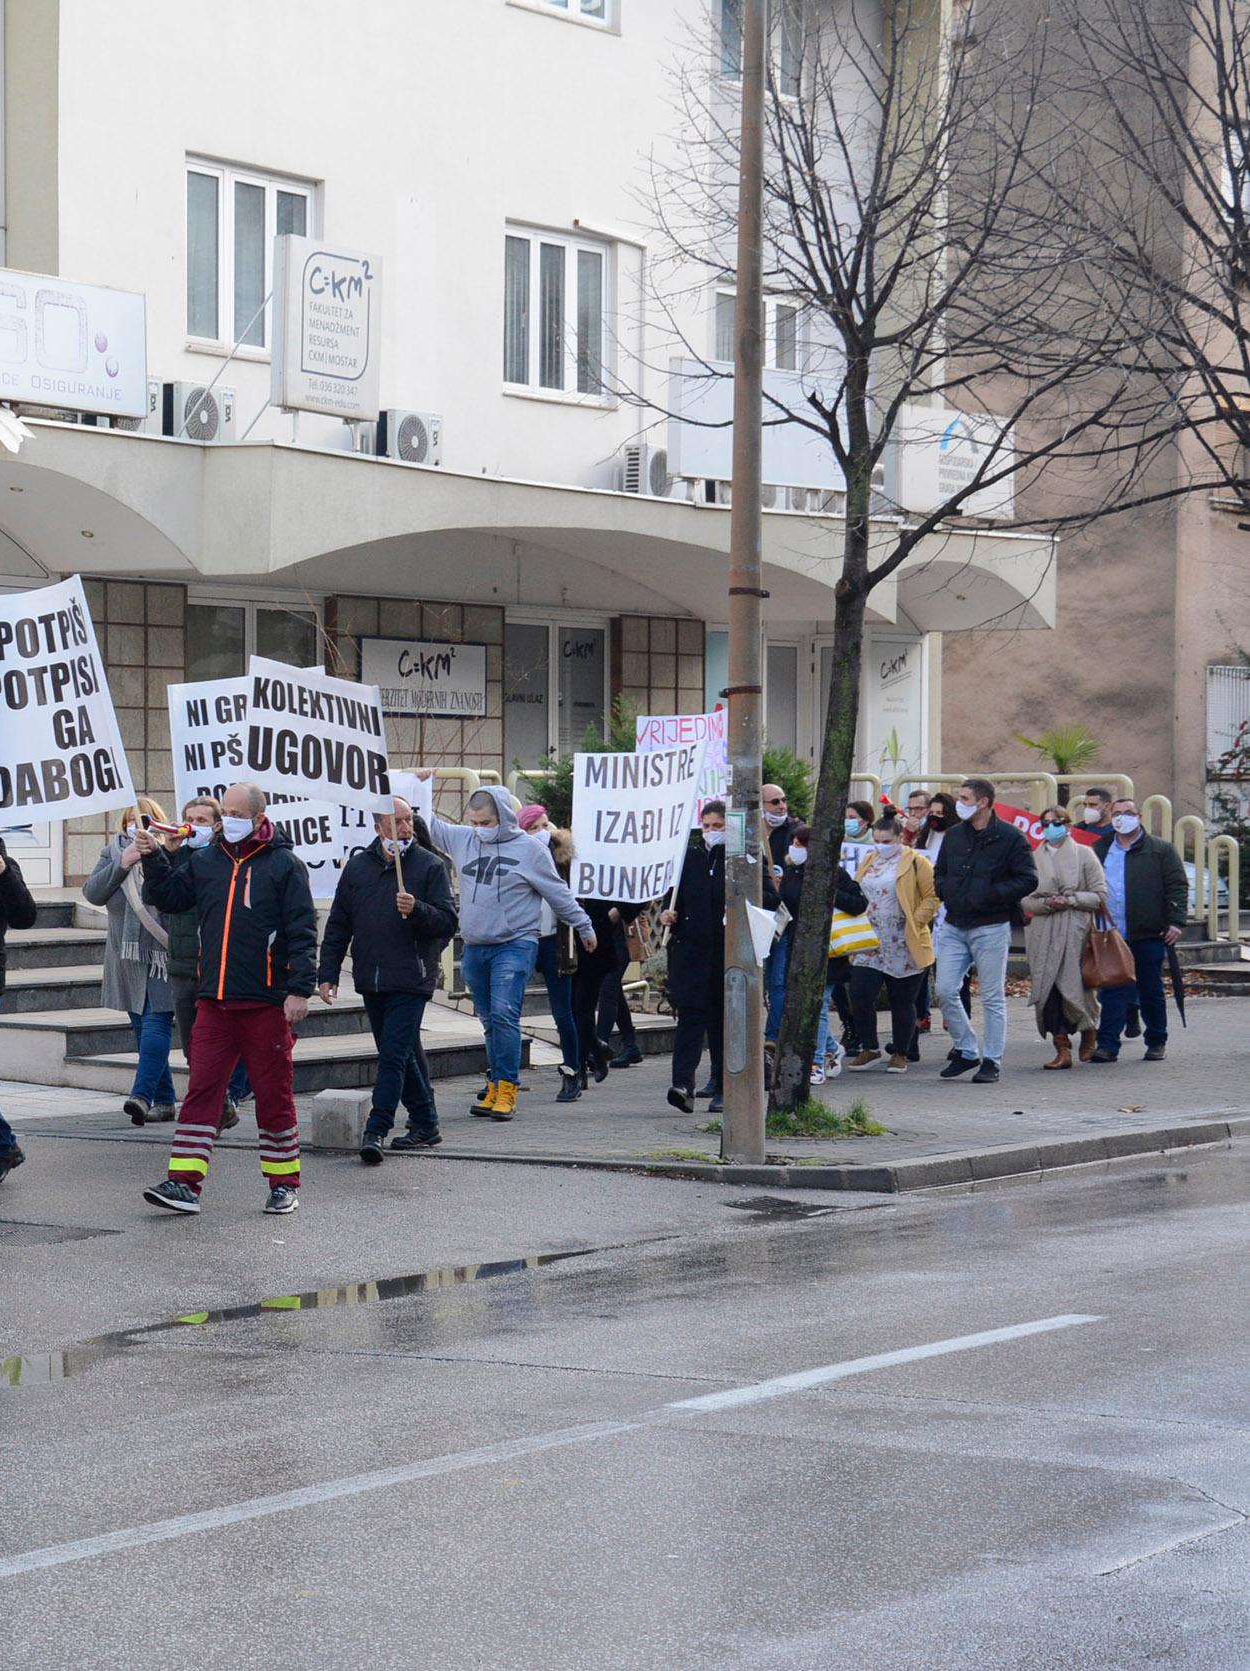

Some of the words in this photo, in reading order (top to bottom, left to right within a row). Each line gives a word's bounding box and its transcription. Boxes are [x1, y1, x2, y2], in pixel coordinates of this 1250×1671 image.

[309, 301, 343, 316] FAKULTET
[344, 308, 354, 320] ZA
[309, 318, 359, 337] MENADŽMENT
[309, 334, 339, 350] RESURSA
[186, 699, 210, 727] NI
[252, 676, 382, 737] KOLEKTIVNI
[52, 705, 95, 750] GA
[183, 742, 207, 772] NI
[247, 725, 391, 795] UGOVOR
[584, 744, 698, 789] MINISTRE
[274, 815, 333, 848] NICE
[595, 808, 663, 844] IZAĐI
[669, 802, 685, 838] IZ
